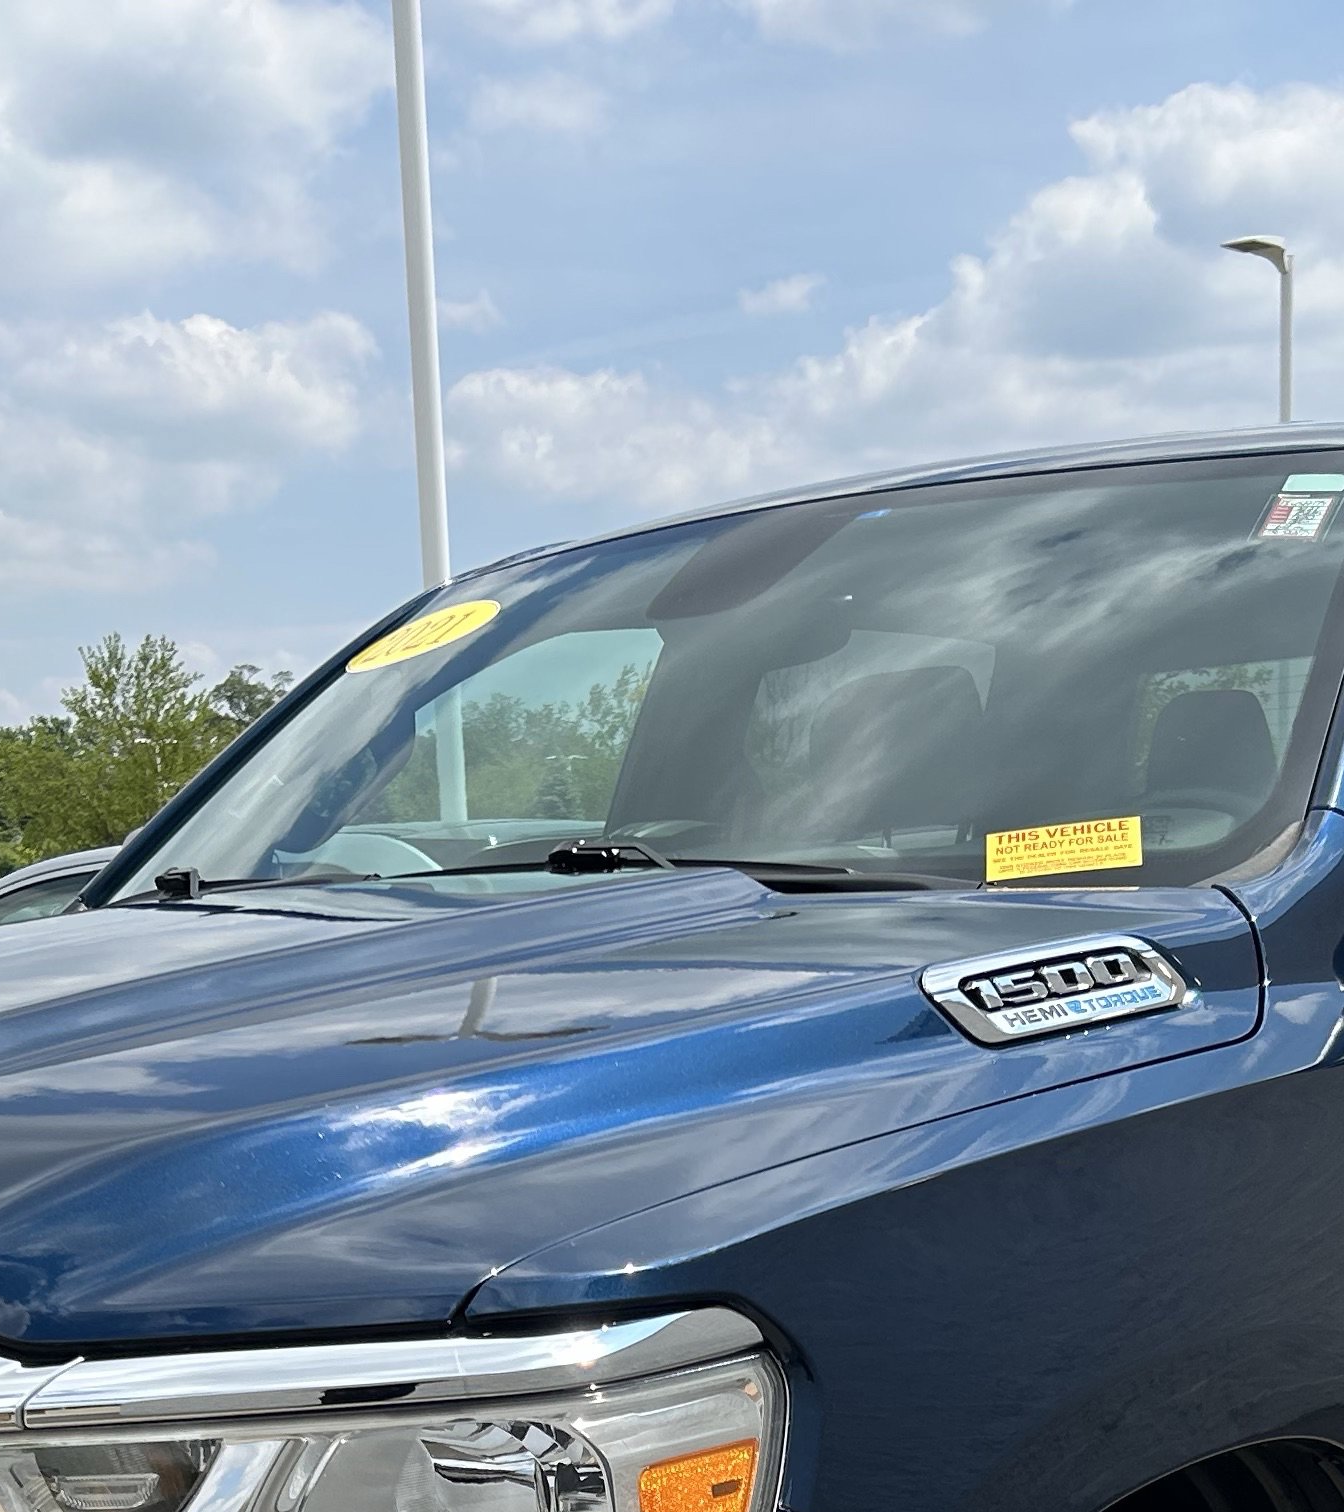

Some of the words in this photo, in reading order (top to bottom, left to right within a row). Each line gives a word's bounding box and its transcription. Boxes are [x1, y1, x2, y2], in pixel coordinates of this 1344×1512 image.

[995, 831, 1040, 845] THIS
[1046, 820, 1130, 839] VEHICLE
[995, 844, 1021, 856] NOT
[1023, 839, 1067, 853] READY
[1069, 836, 1094, 847] FOR
[1097, 832, 1129, 844] SALE
[965, 953, 1138, 1008] 1500
[1003, 1003, 1067, 1028] HEMI
